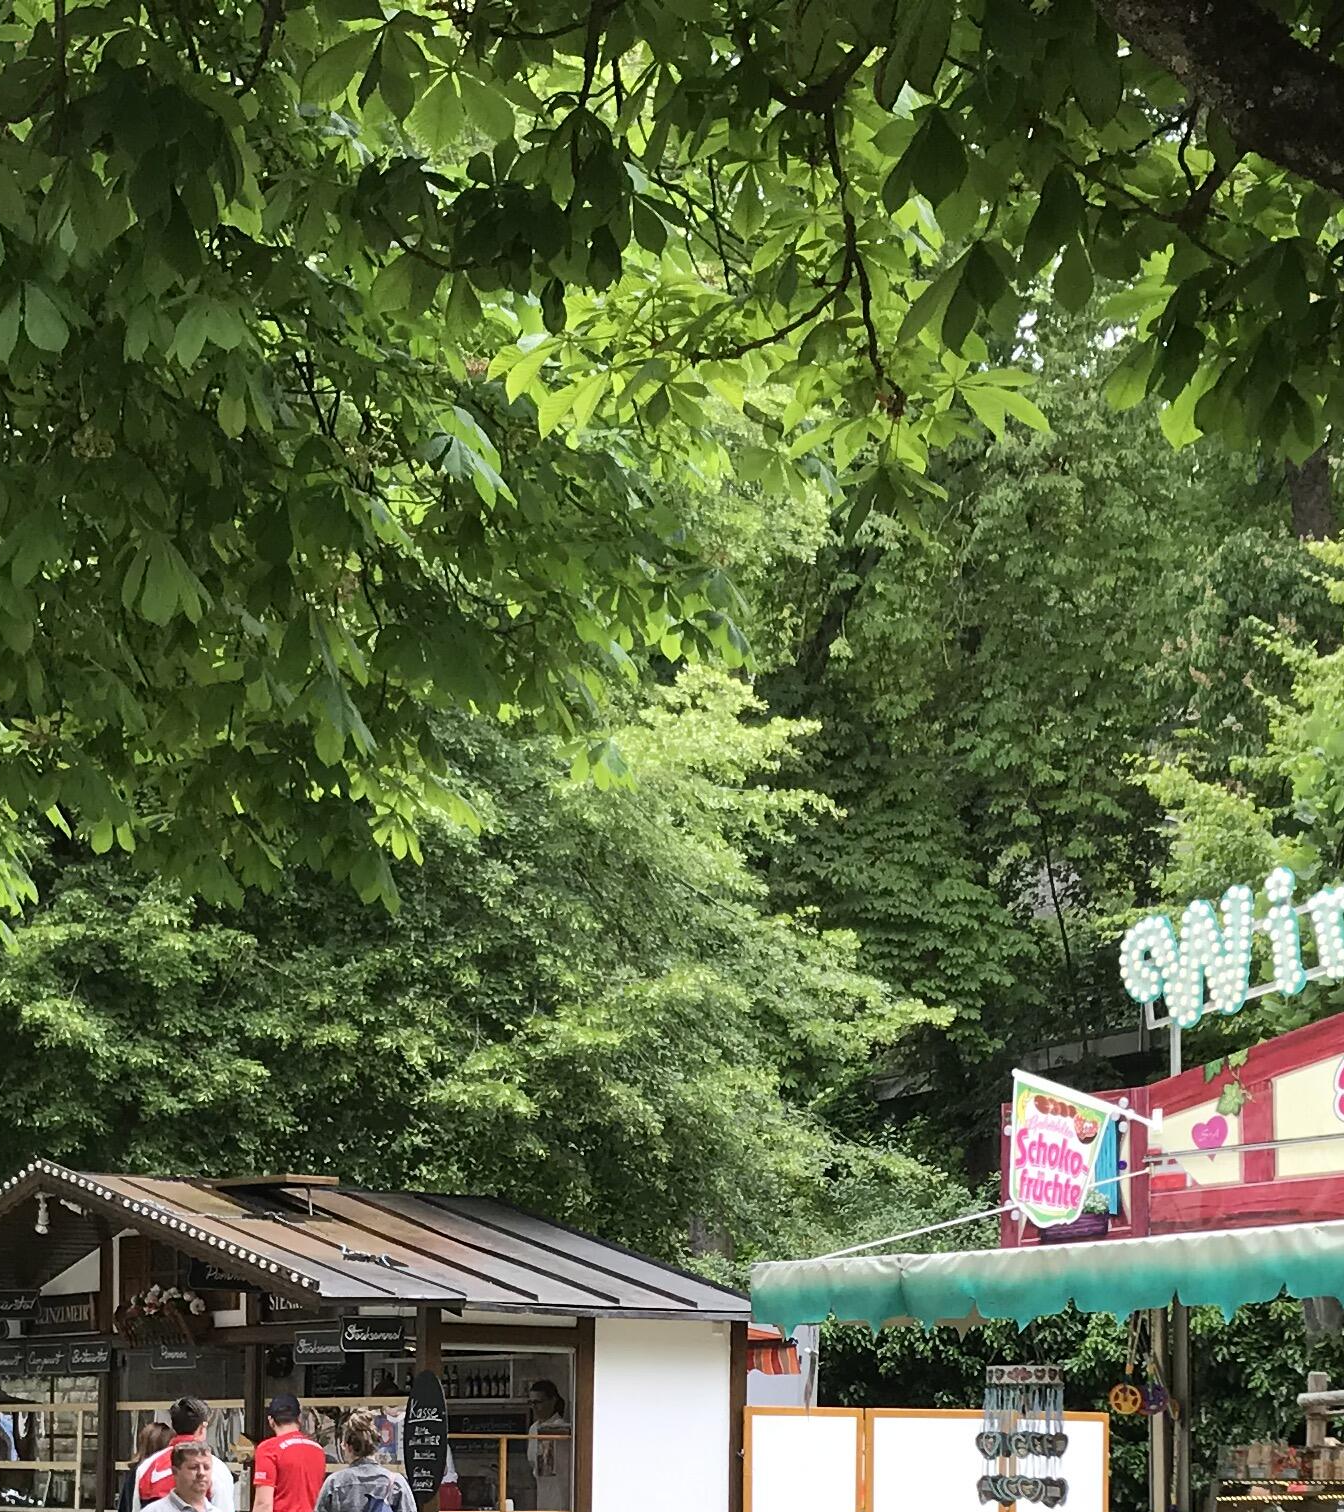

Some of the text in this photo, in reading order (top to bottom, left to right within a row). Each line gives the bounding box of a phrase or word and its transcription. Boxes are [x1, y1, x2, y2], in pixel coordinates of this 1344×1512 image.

[1015, 1128, 1089, 1177] Schoko-
[1019, 1169, 1082, 1209] früchte
[409, 1399, 439, 1419] Kasse
